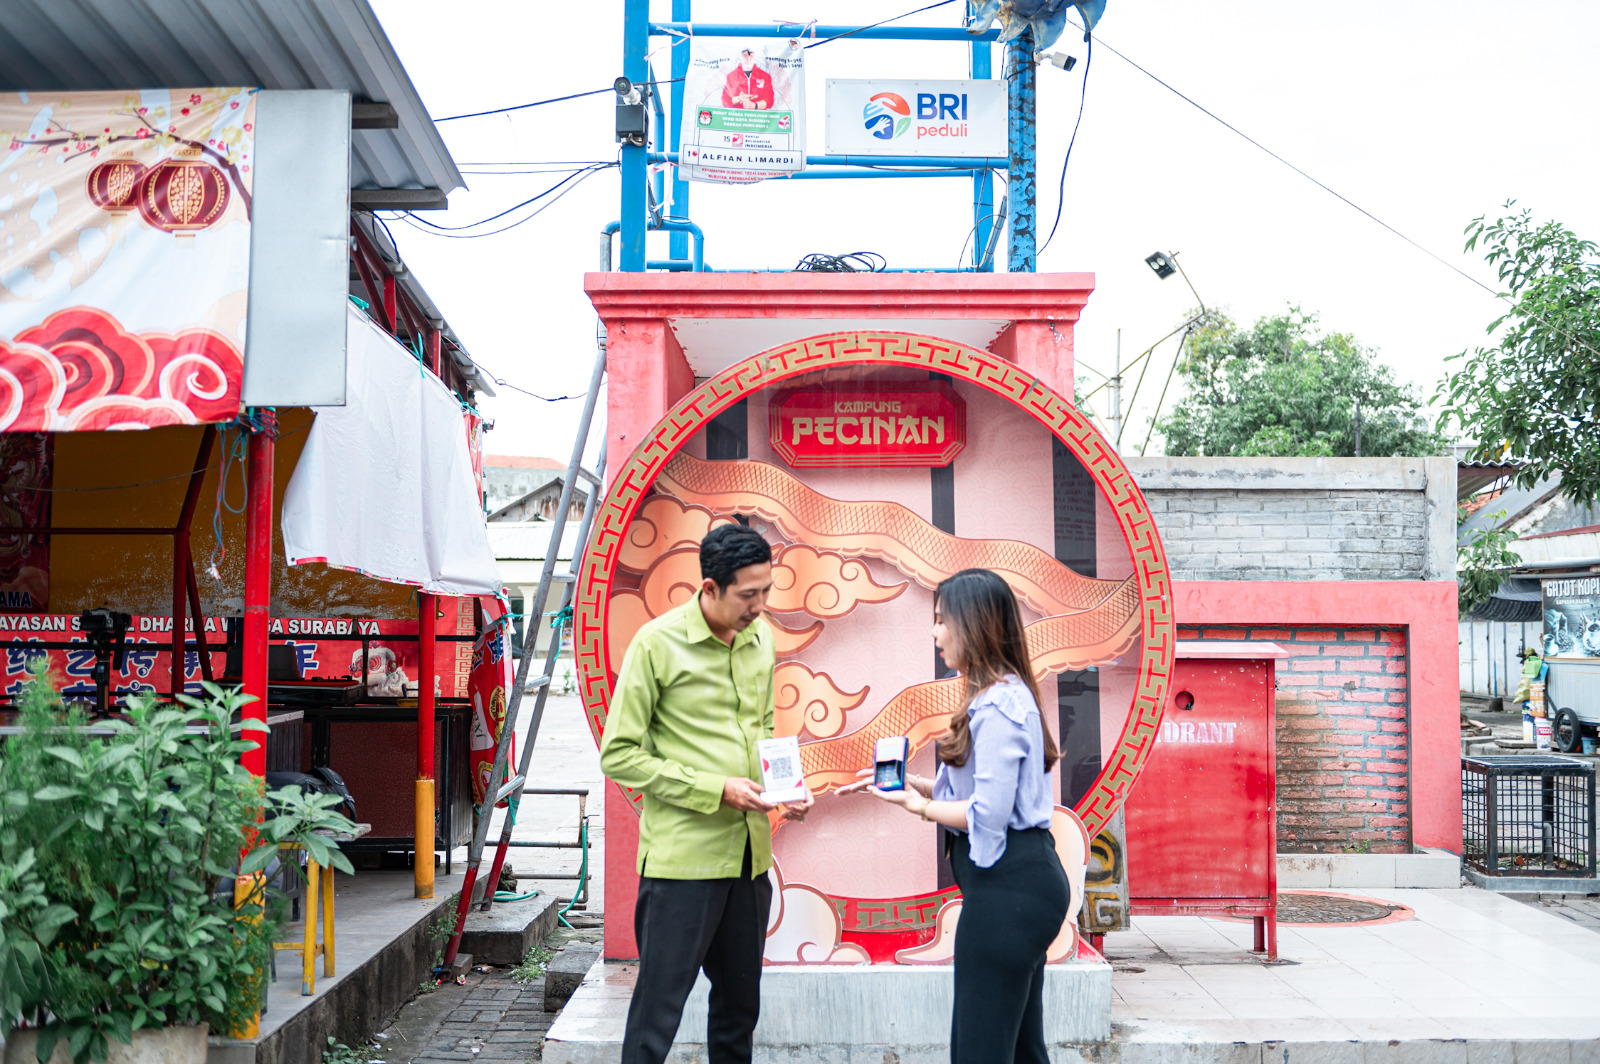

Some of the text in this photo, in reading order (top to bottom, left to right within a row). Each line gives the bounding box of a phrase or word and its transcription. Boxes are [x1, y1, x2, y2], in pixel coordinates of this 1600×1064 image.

[917, 93, 968, 121] BRI
[917, 123, 968, 139] peduli
[702, 153, 794, 164] ALFIAN LIMARDI
[834, 400, 902, 414] KAMPUNG
[791, 414, 946, 446] PECINAN
[1546, 577, 1600, 597] GATOT KOPI
